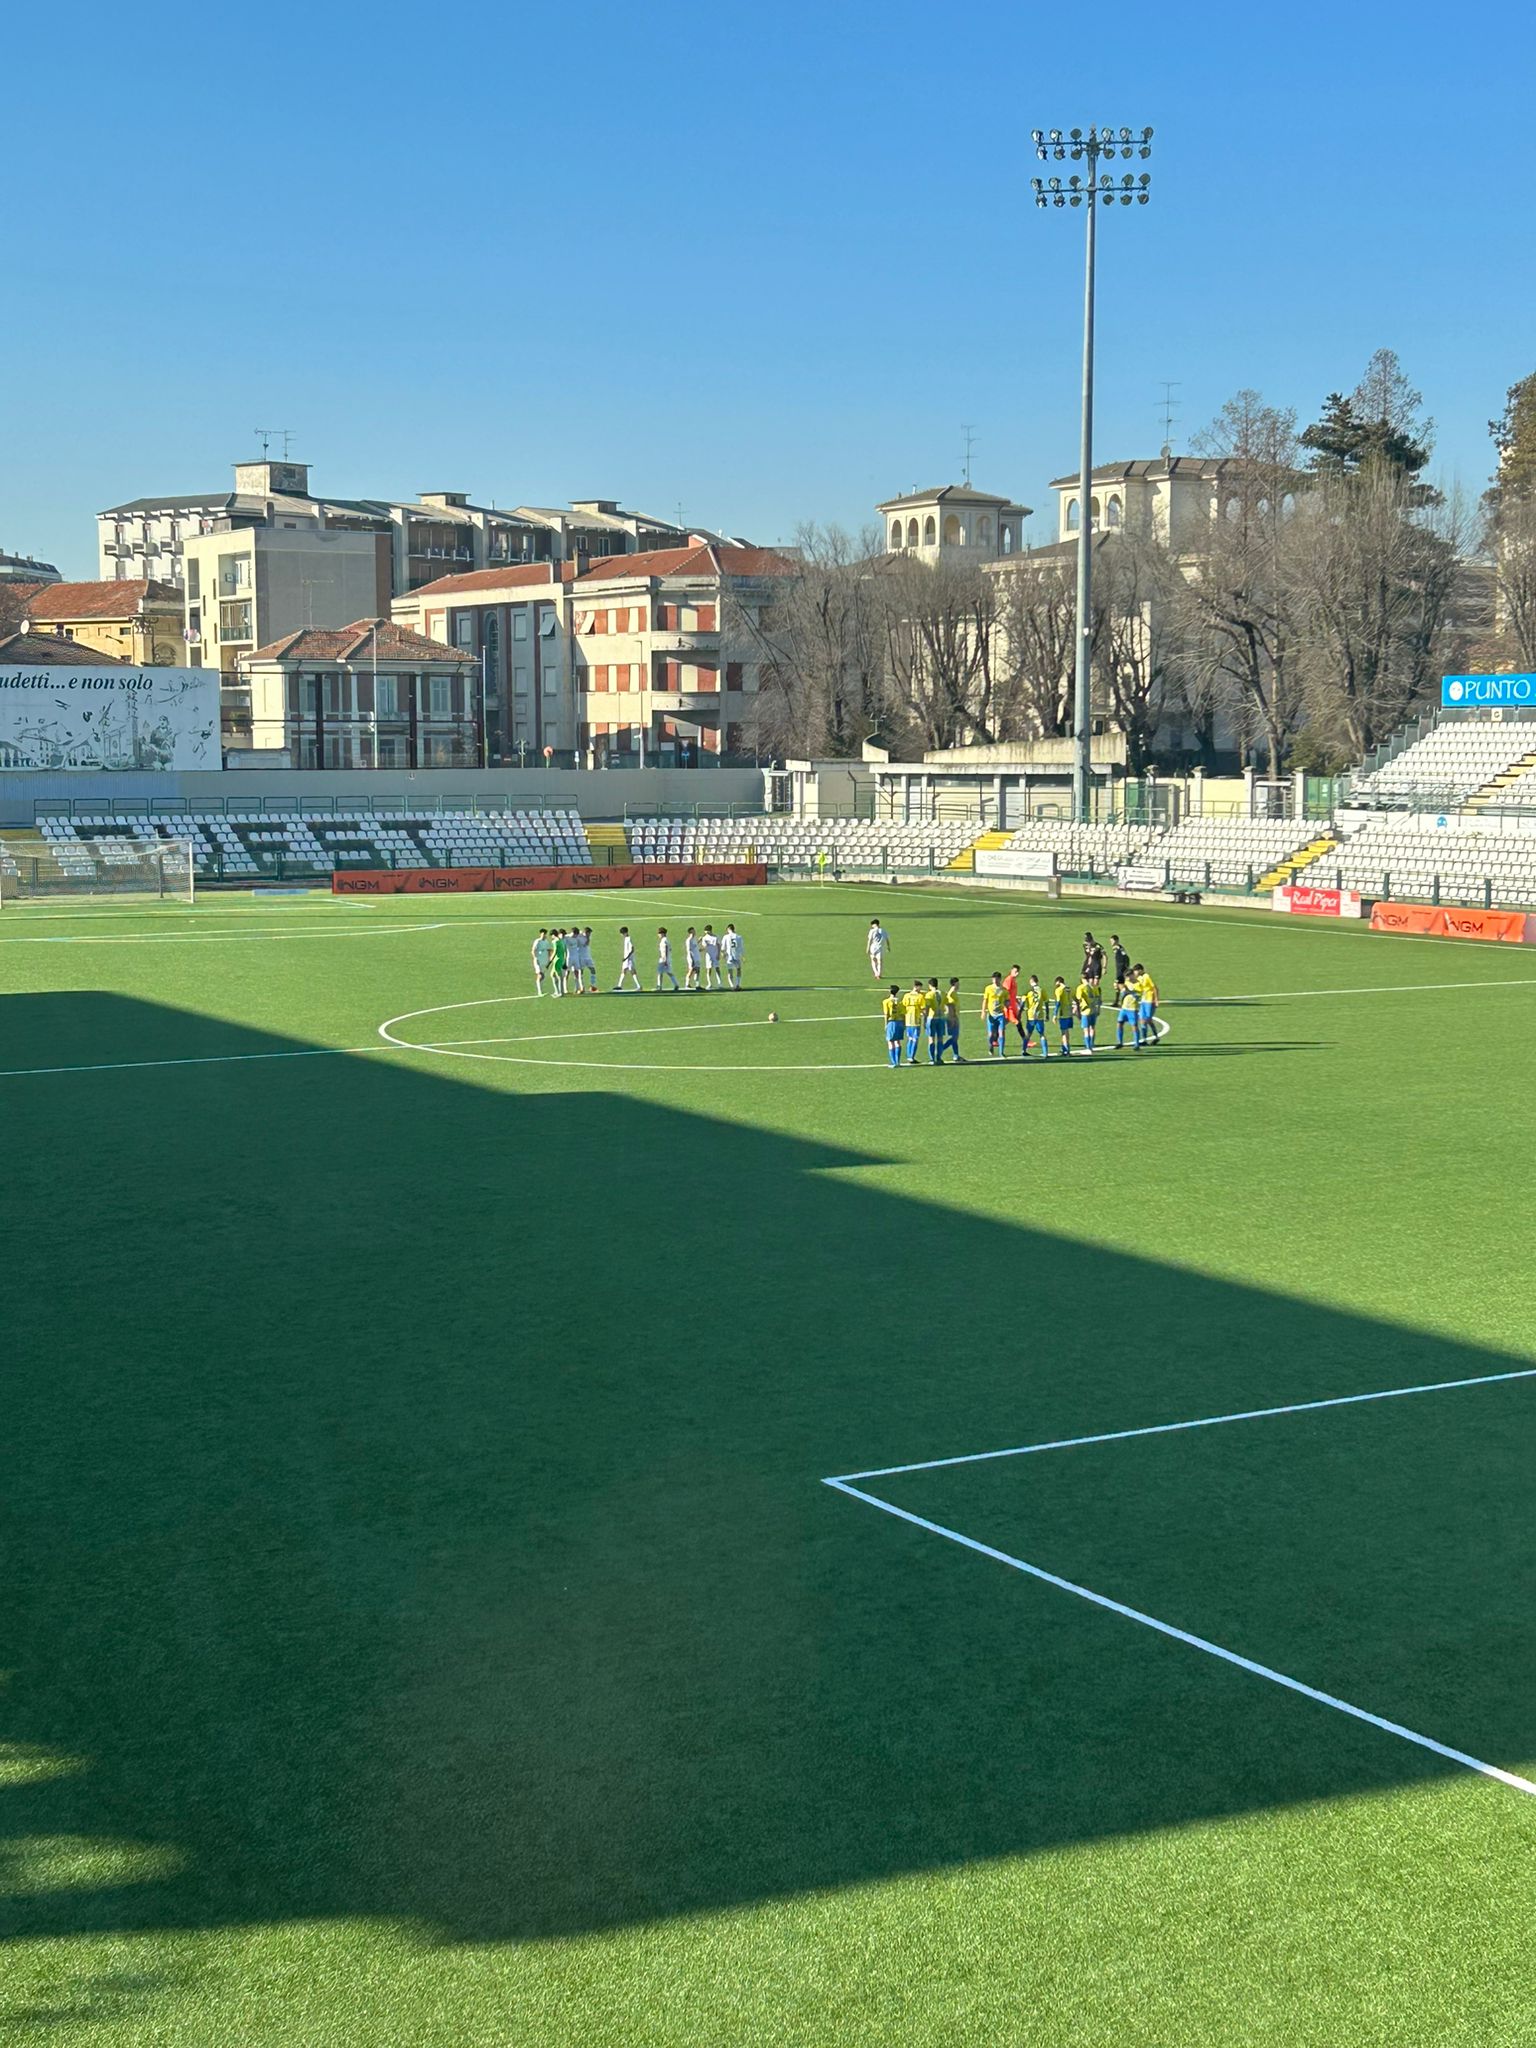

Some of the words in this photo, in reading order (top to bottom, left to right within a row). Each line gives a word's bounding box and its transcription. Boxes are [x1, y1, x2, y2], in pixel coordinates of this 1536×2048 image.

[81, 677, 115, 690] non
[118, 673, 153, 690] solo
[1465, 680, 1530, 699] PUNTO
